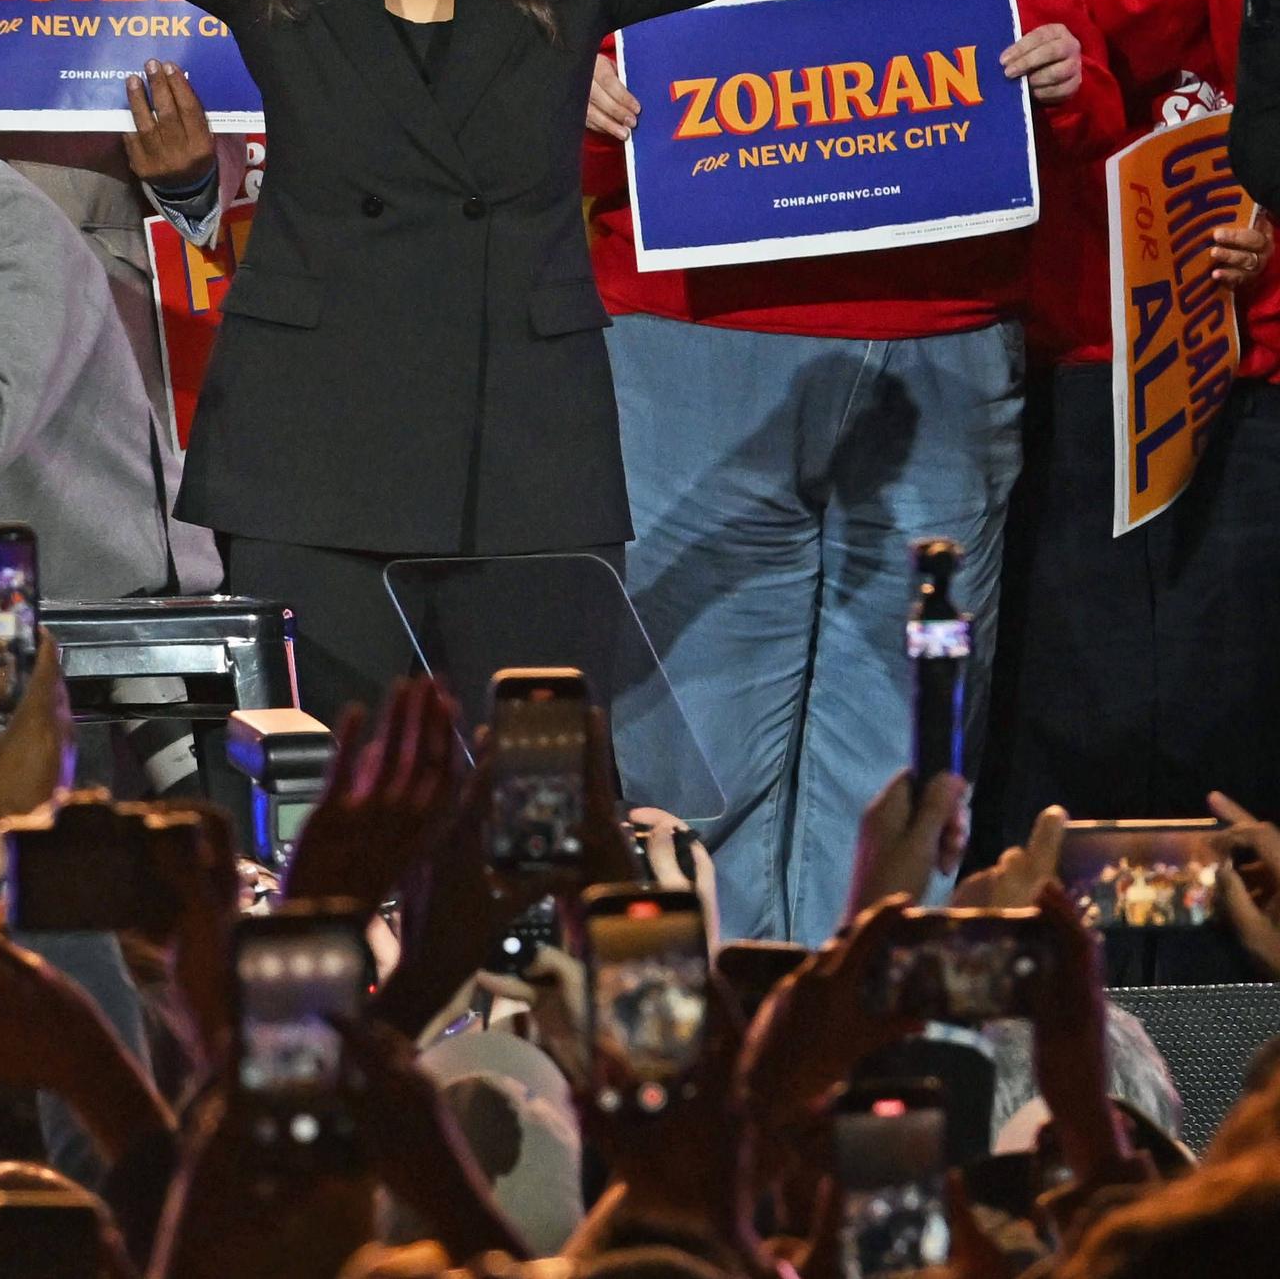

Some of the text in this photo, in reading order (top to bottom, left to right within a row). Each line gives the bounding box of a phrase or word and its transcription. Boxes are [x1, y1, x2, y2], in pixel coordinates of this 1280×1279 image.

[31, 15, 101, 37] NEW
[107, 16, 192, 37] YORK
[198, 16, 230, 37] CI
[60, 70, 189, 80] ZOHRANFONM
[669, 45, 984, 140] ZOHRAN
[691, 121, 970, 176] FOR NEW YORK CITY
[772, 184, 901, 209] ZOHRANFORNYC.COM
[1128, 180, 1187, 495] FOR ALL
